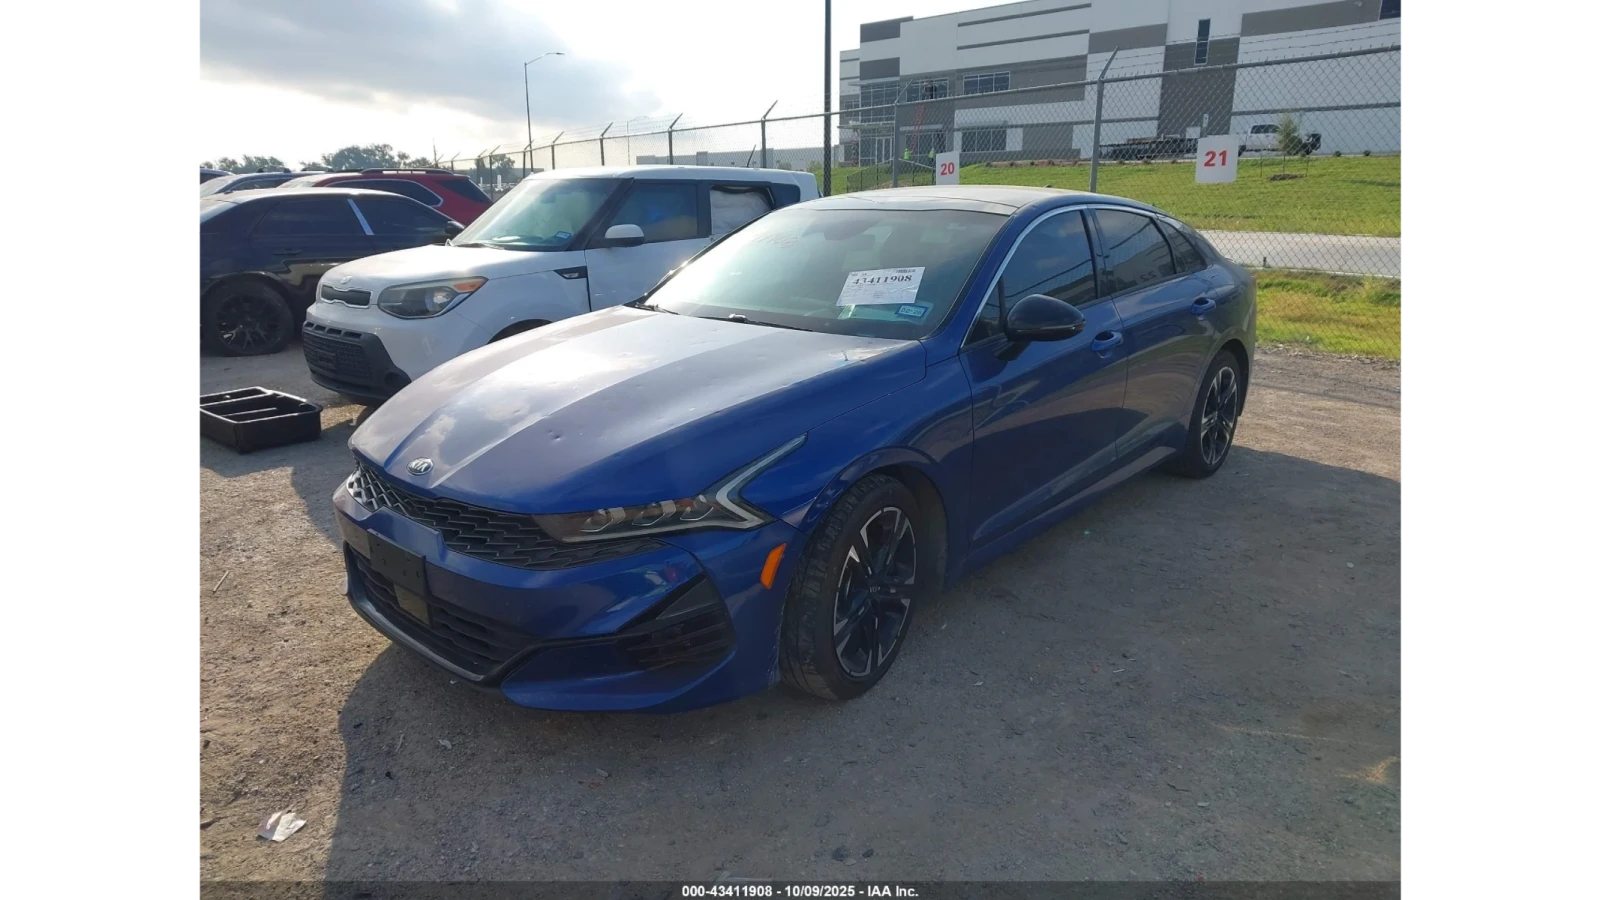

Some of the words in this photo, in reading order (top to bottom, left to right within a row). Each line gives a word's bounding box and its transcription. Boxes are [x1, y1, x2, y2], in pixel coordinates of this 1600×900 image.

[1203, 150, 1228, 167] 21
[940, 161, 955, 176] 20
[852, 274, 913, 285] 43411908
